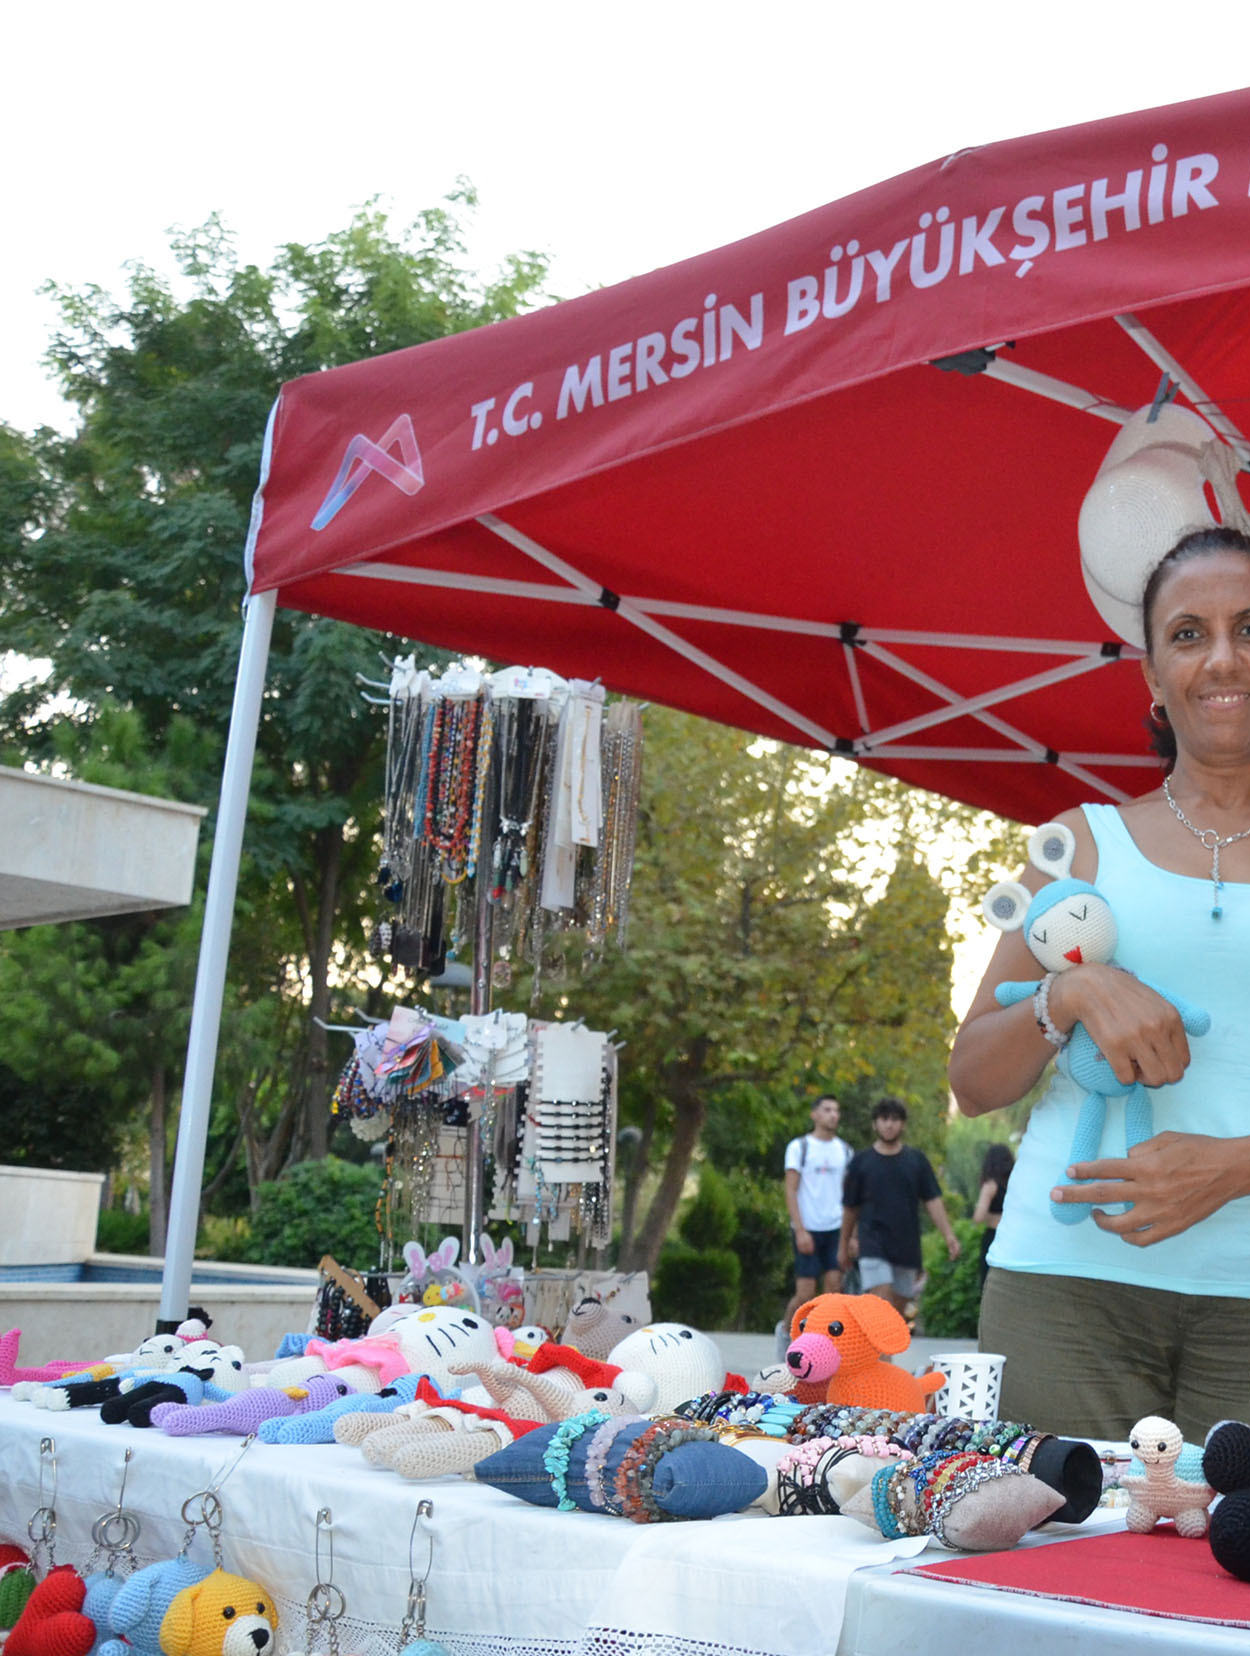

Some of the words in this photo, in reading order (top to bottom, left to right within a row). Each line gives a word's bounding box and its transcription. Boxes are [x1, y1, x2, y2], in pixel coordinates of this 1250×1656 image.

[471, 382, 542, 451] T.C.
[556, 293, 764, 420] MERSİN
[783, 143, 1220, 337] BÜYÜKŞEHİR
